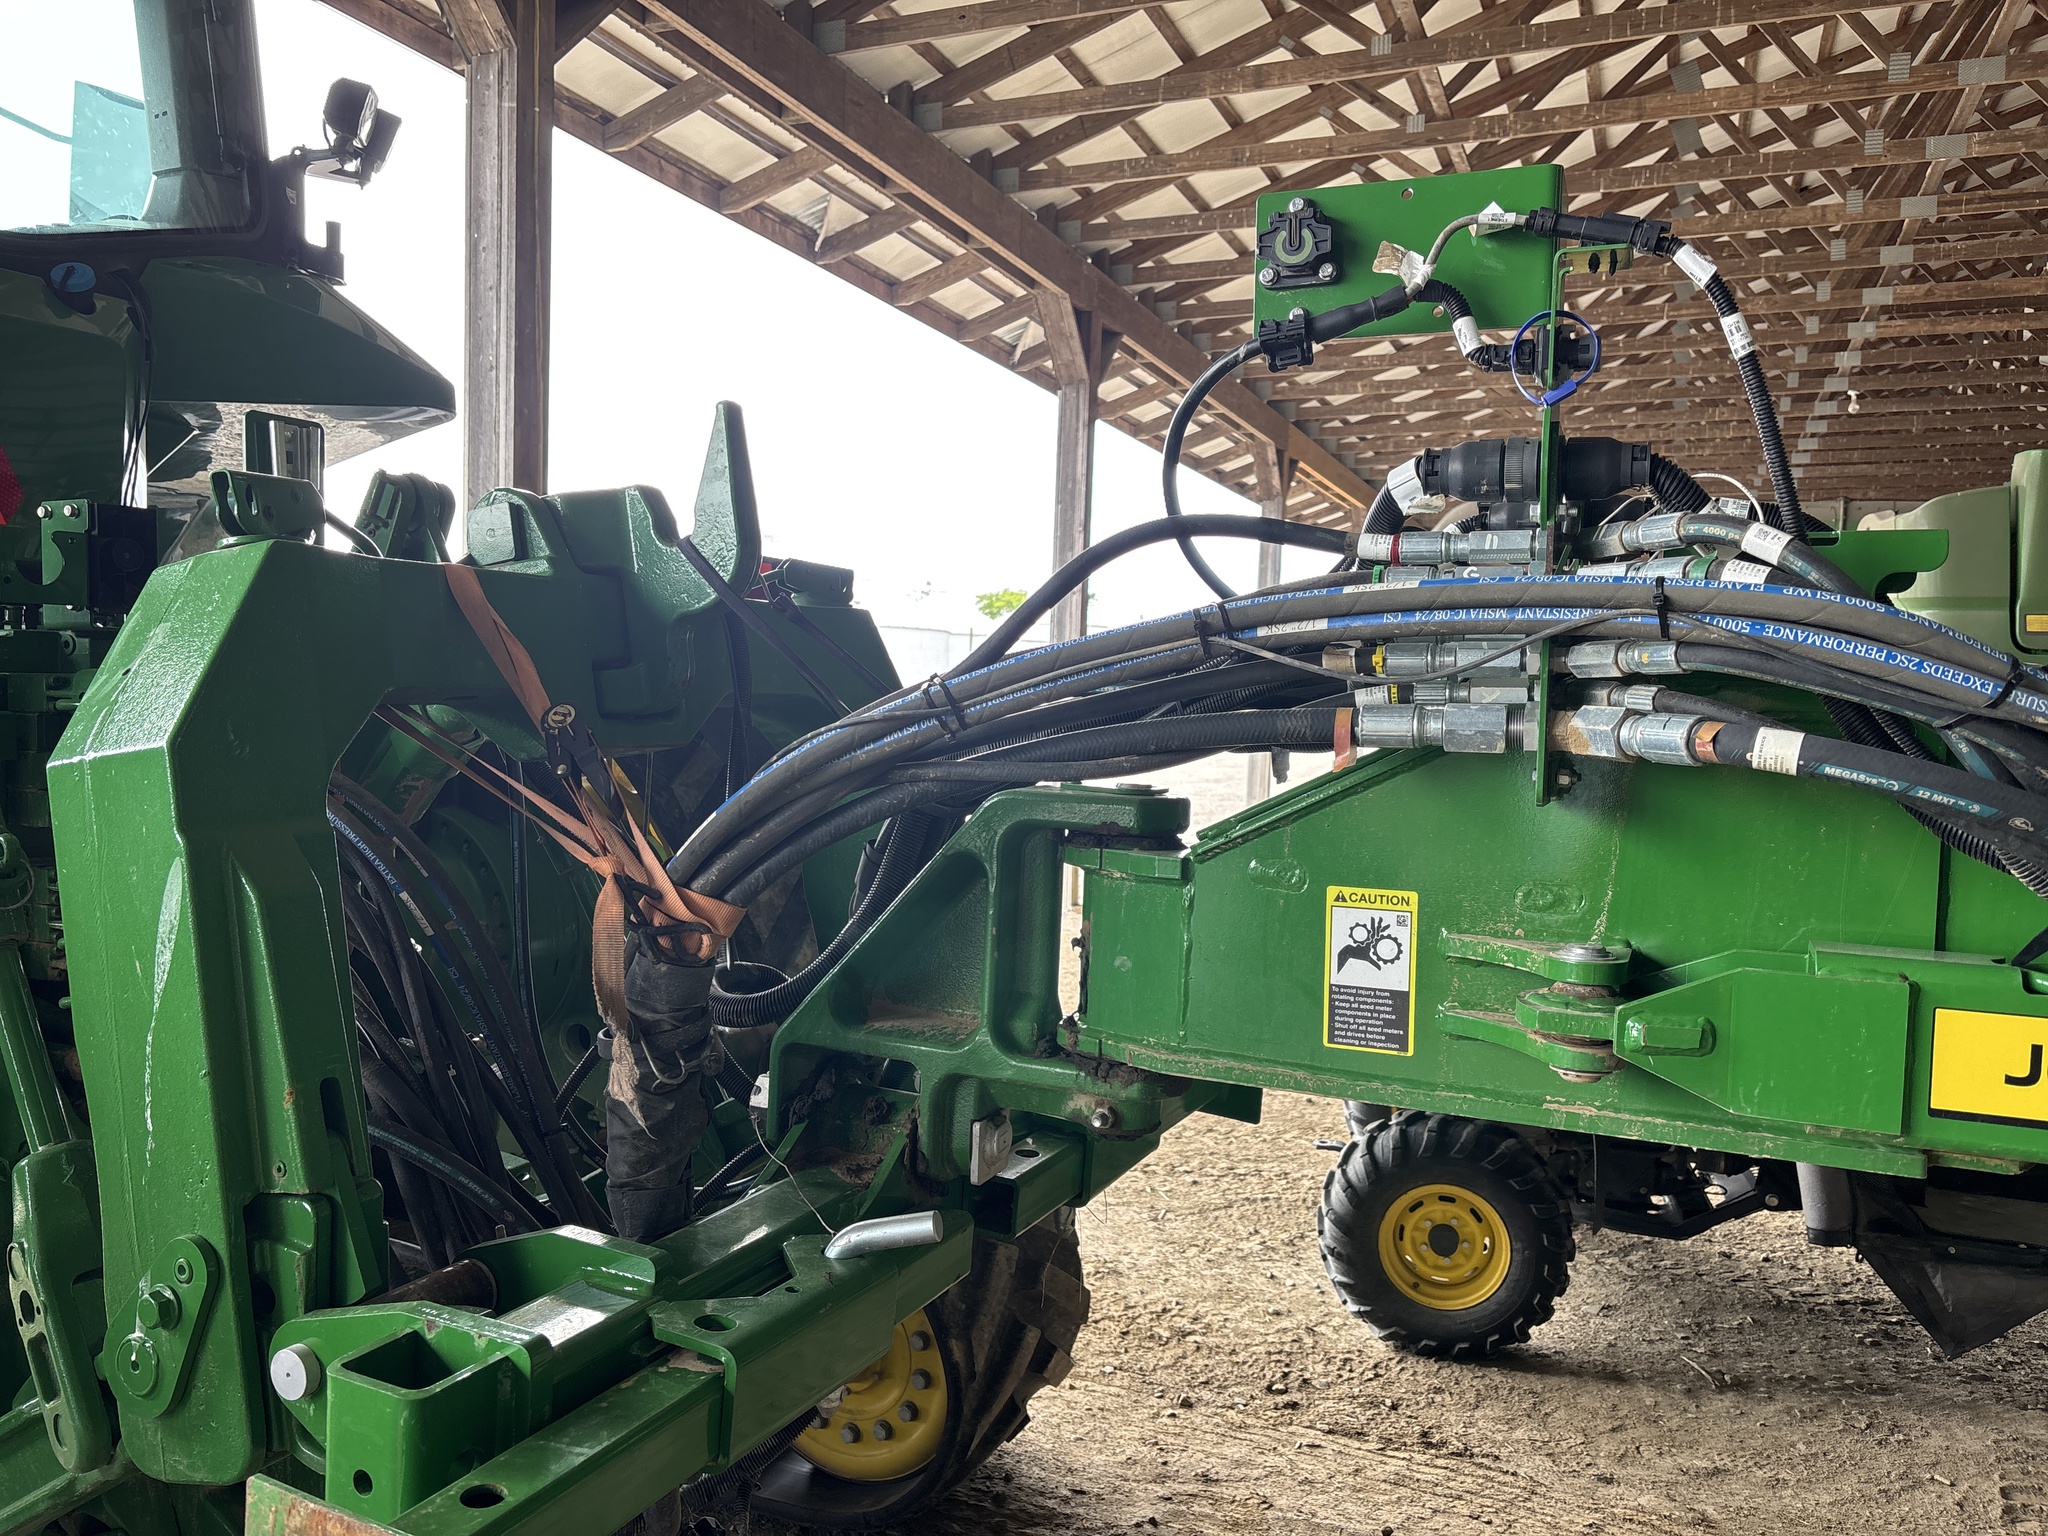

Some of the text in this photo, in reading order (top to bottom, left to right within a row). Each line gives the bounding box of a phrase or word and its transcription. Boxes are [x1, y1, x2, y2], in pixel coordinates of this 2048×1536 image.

[1703, 526, 1726, 536] 4000
[1728, 532, 1742, 540] ps
[1574, 575, 1614, 584] MSHA
[1709, 581, 1765, 592] FLAME
[1783, 586, 1812, 598] WP
[1816, 591, 1840, 602] PSI
[1845, 596, 1886, 612] 5000
[1383, 612, 1401, 622] CSI
[1414, 609, 1466, 622] IC-08/24
[1470, 608, 1508, 619] MSHA
[1516, 608, 1589, 620] RESISTANT
[1266, 619, 1317, 634] 1/2" 2SK
[1714, 618, 1752, 633] 5000
[1762, 624, 1886, 662] PERFORMANCE
[1898, 611, 2008, 662] PERFORMANCE
[1889, 650, 1920, 670] 2SC
[1922, 661, 1994, 695] EXCEEDS
[1916, 790, 1932, 798] 12
[356, 840, 376, 862] HIGH
[372, 858, 398, 886] EXTRA
[1349, 892, 1410, 906] CAUTION
[448, 966, 460, 979] CSI
[1355, 996, 1394, 1004] components:
[1335, 1009, 1371, 1017] components
[474, 1013, 491, 1036] MSHA
[1334, 1037, 1359, 1045] cleaning
[458, 1175, 469, 1184] psi
